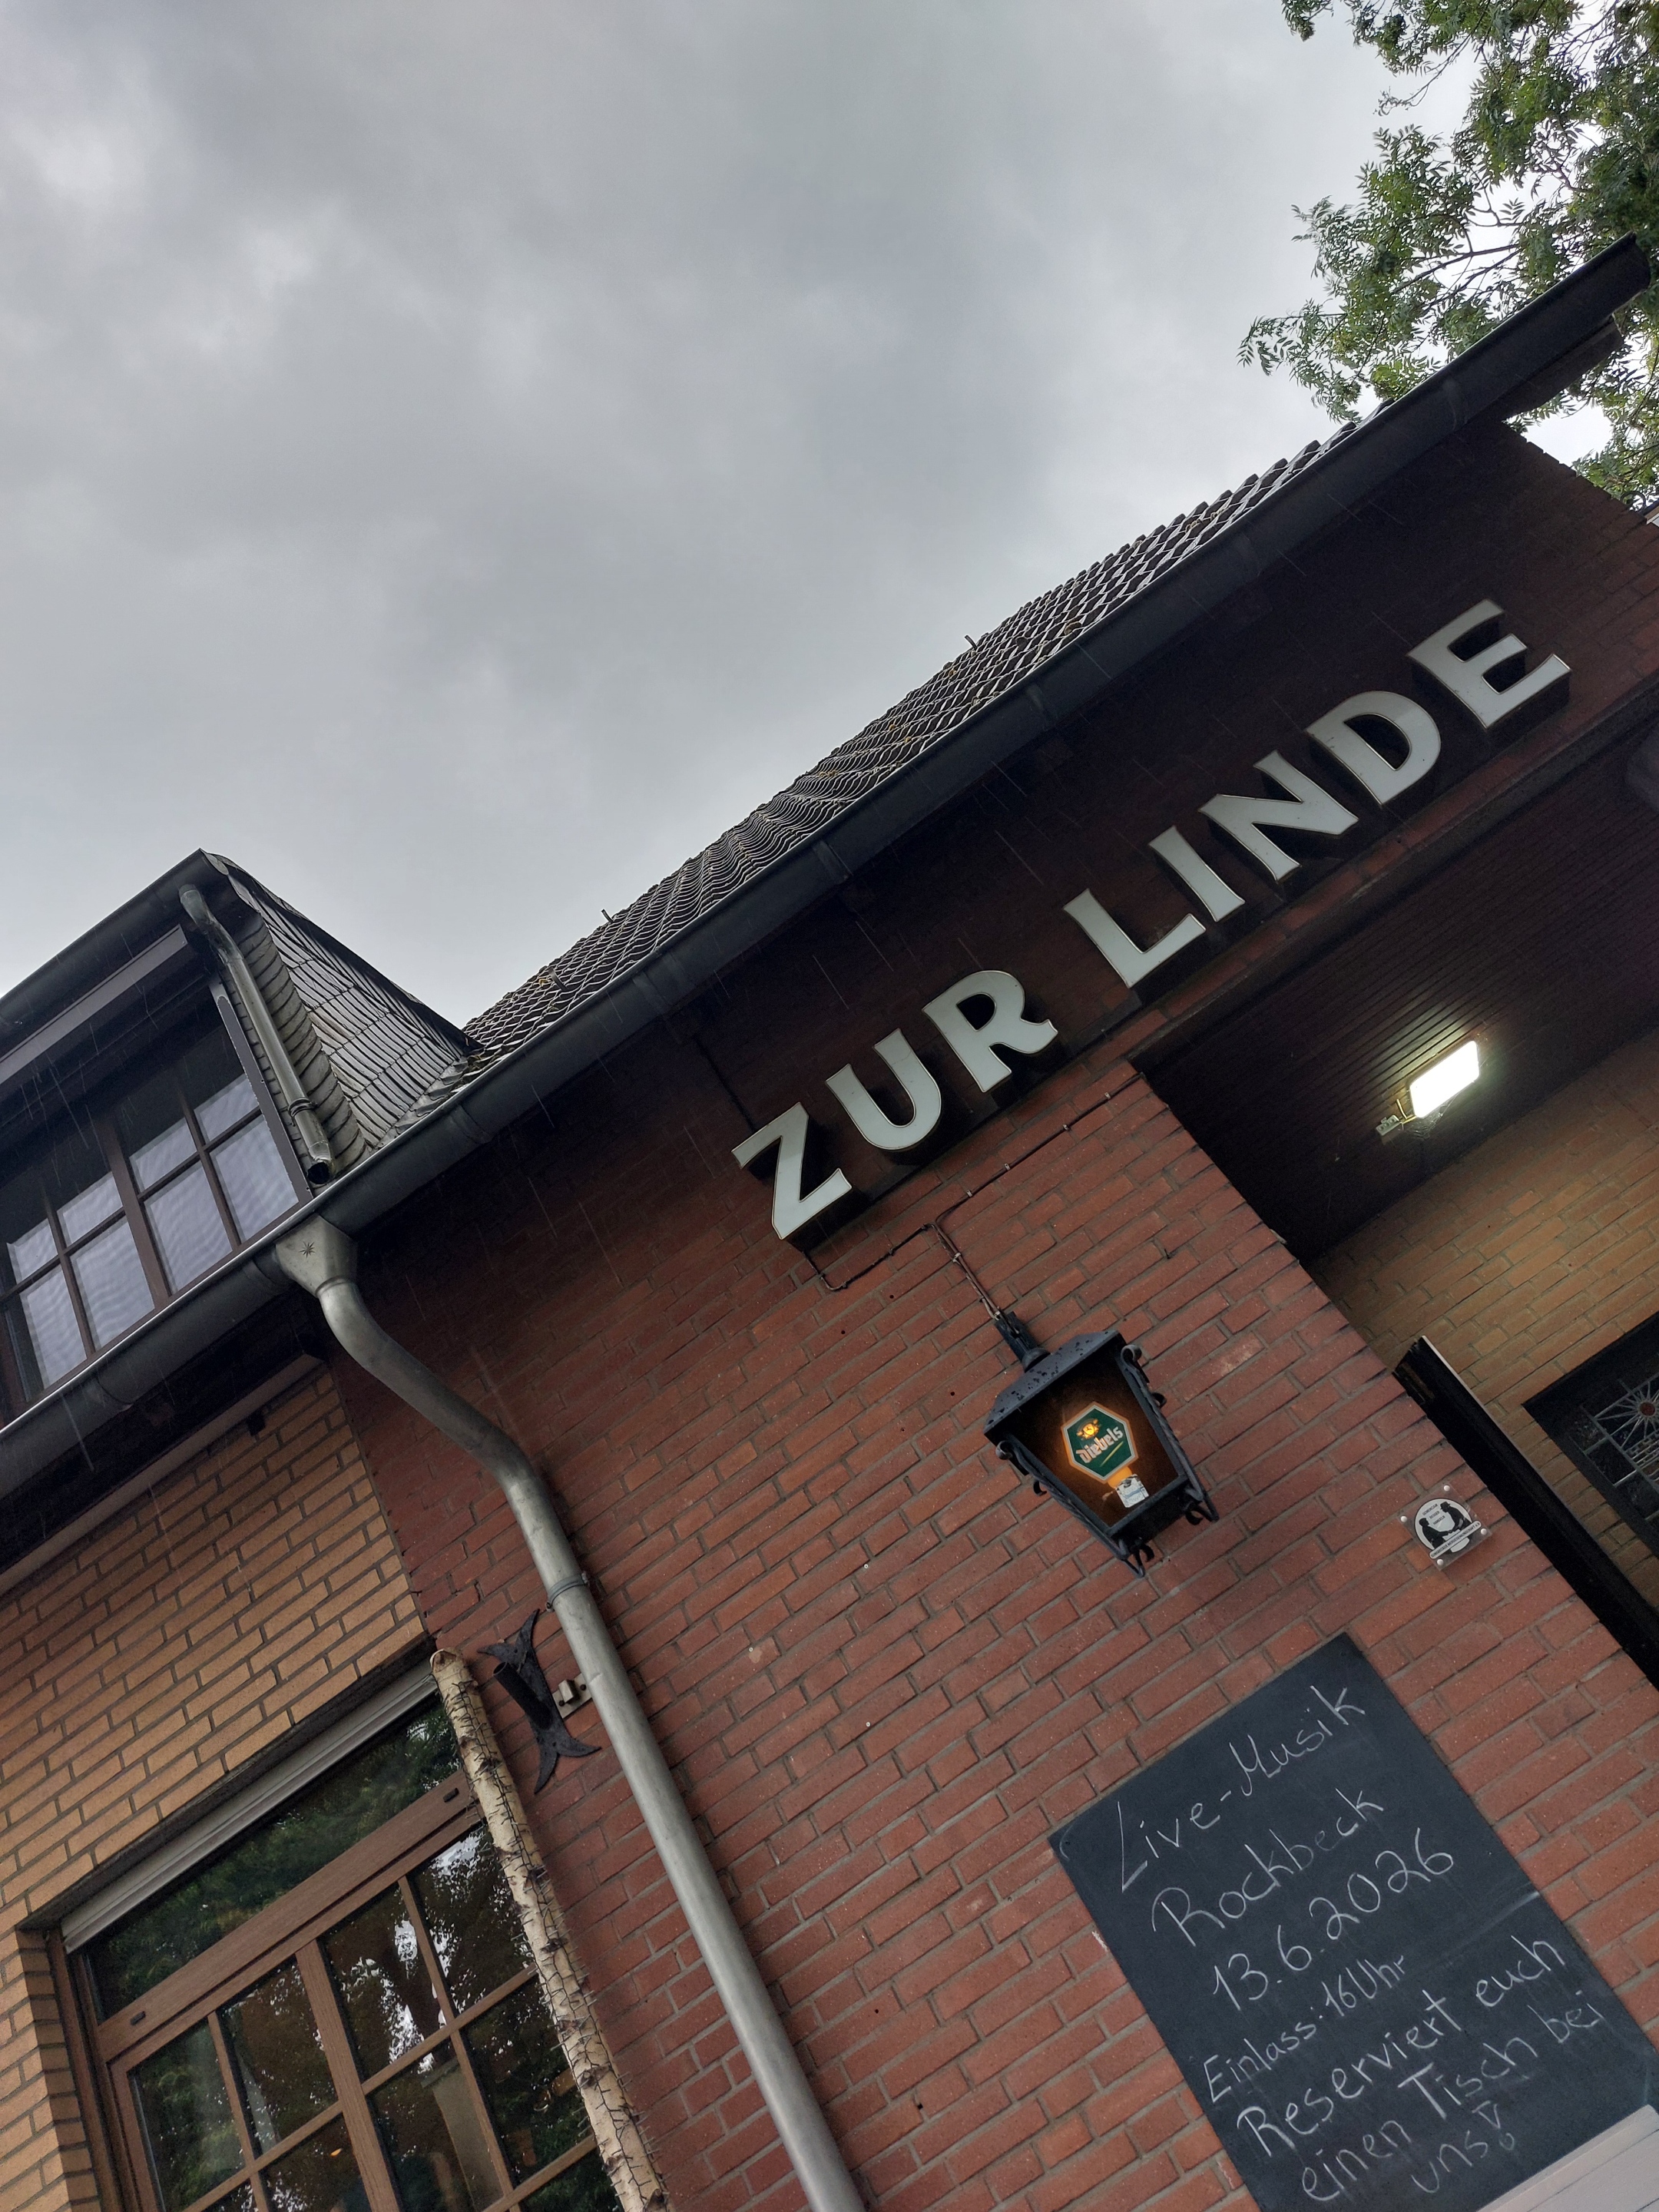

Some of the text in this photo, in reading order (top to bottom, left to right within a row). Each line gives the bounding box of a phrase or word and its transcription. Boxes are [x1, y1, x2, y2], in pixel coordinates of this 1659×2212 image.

[731, 598, 1571, 1240] ZUR LINDE
[1076, 1426, 1124, 1464] Diebels
[1118, 1686, 1365, 1892] Live-Musik
[1151, 1788, 1383, 1946] Rockbeck
[1213, 1828, 1454, 2011] 13.6.2026
[1237, 1935, 1566, 2157] Reserviert euch
[1302, 1990, 1604, 2201] einen Tisch bei
